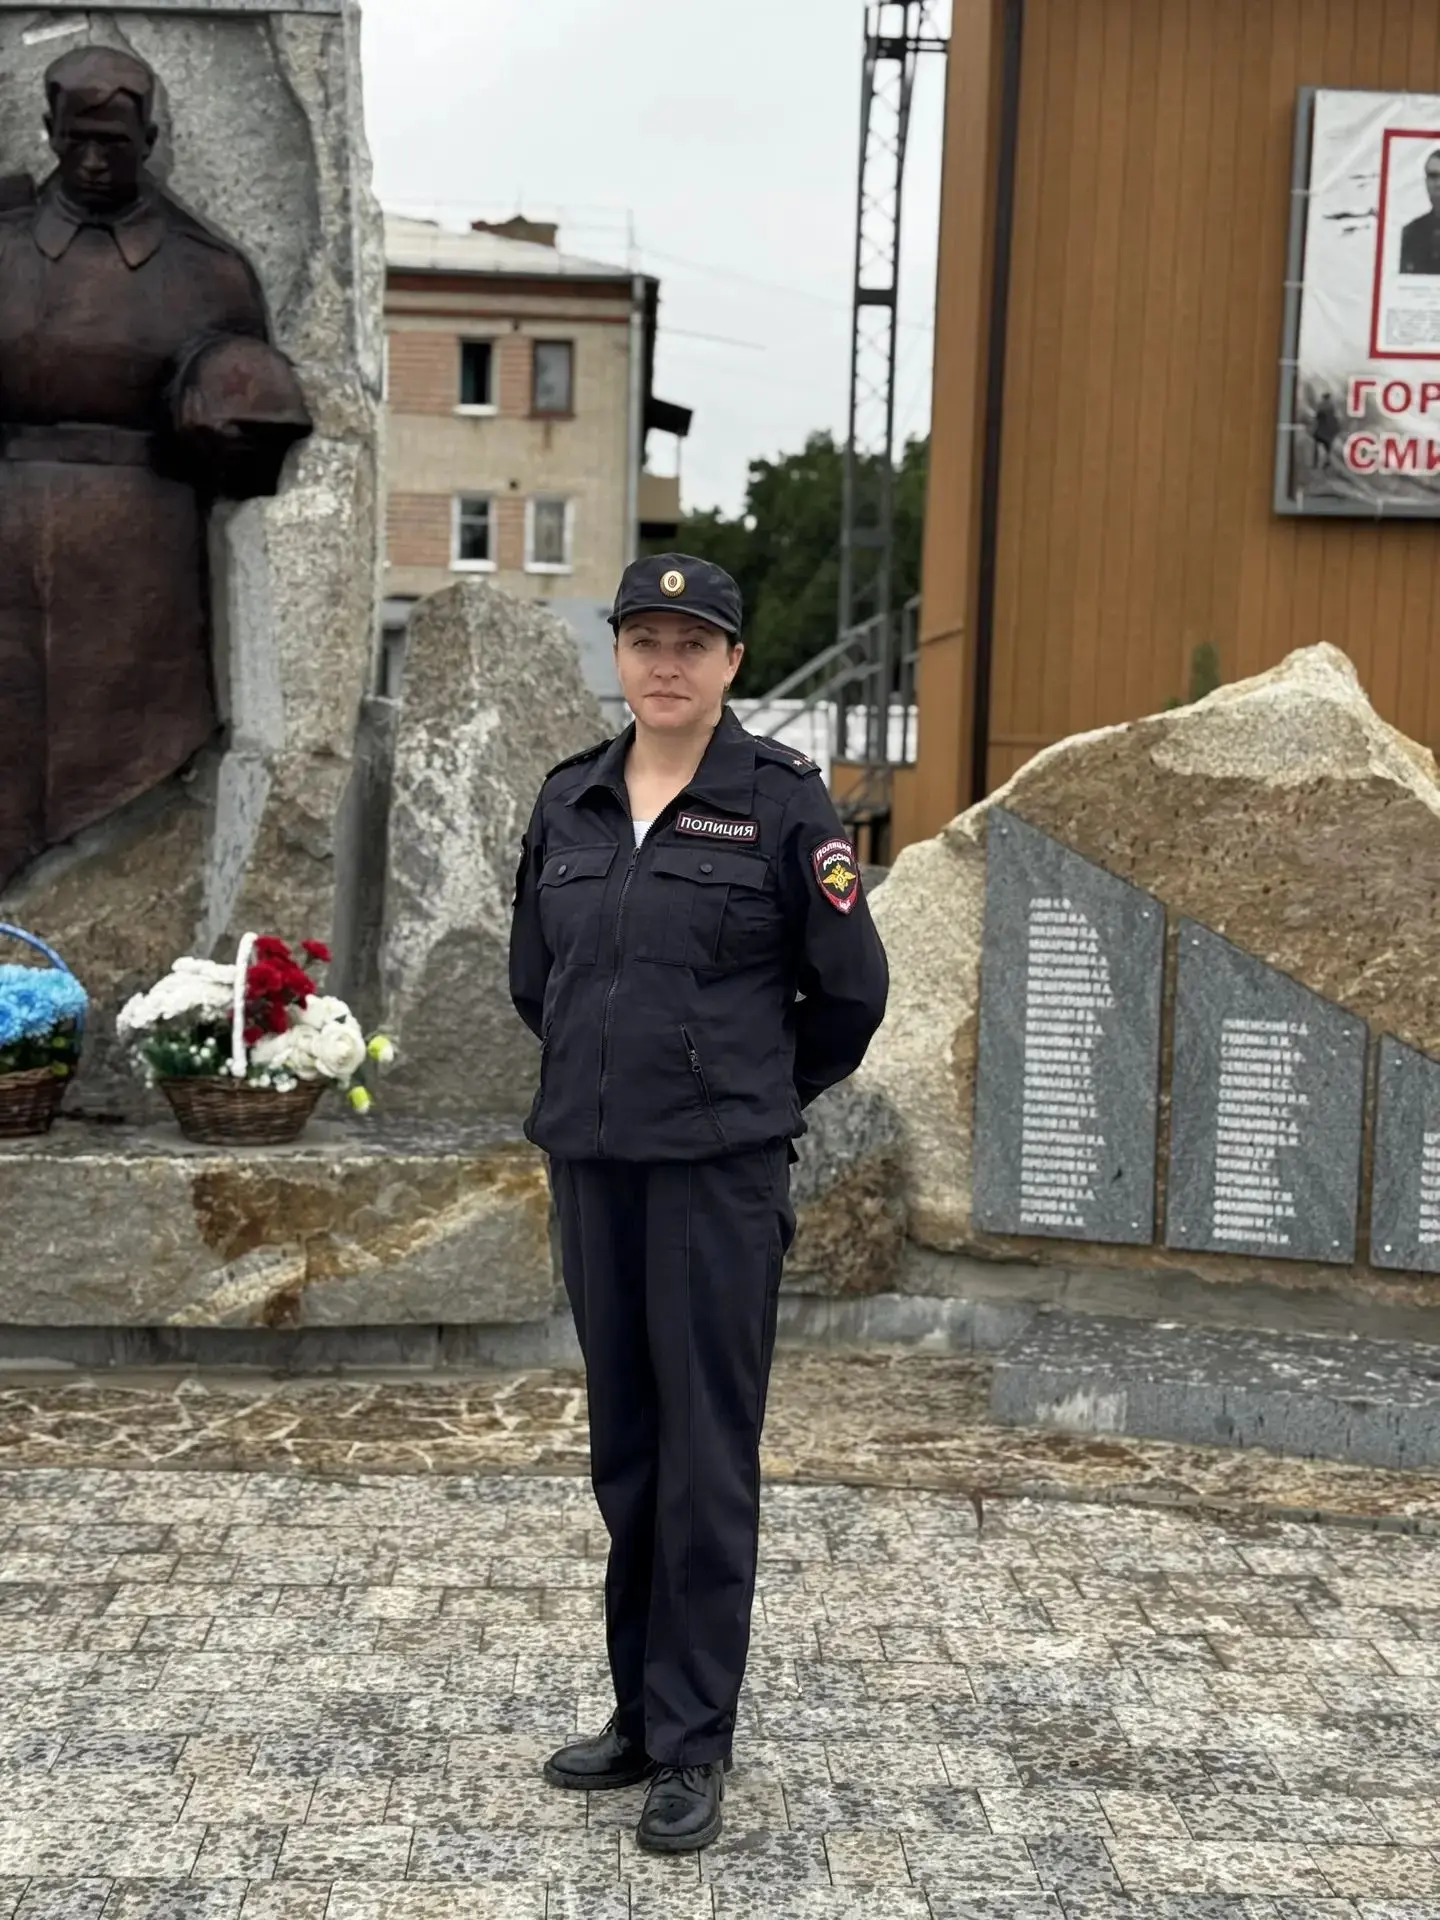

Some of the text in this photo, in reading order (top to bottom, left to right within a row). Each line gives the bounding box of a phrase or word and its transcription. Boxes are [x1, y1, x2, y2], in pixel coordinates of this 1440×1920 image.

[1352, 380, 1440, 413] ГОР
[680, 816, 755, 838] ПОЛИЦИЯ
[816, 841, 852, 861] ПОЛИЦИЯ
